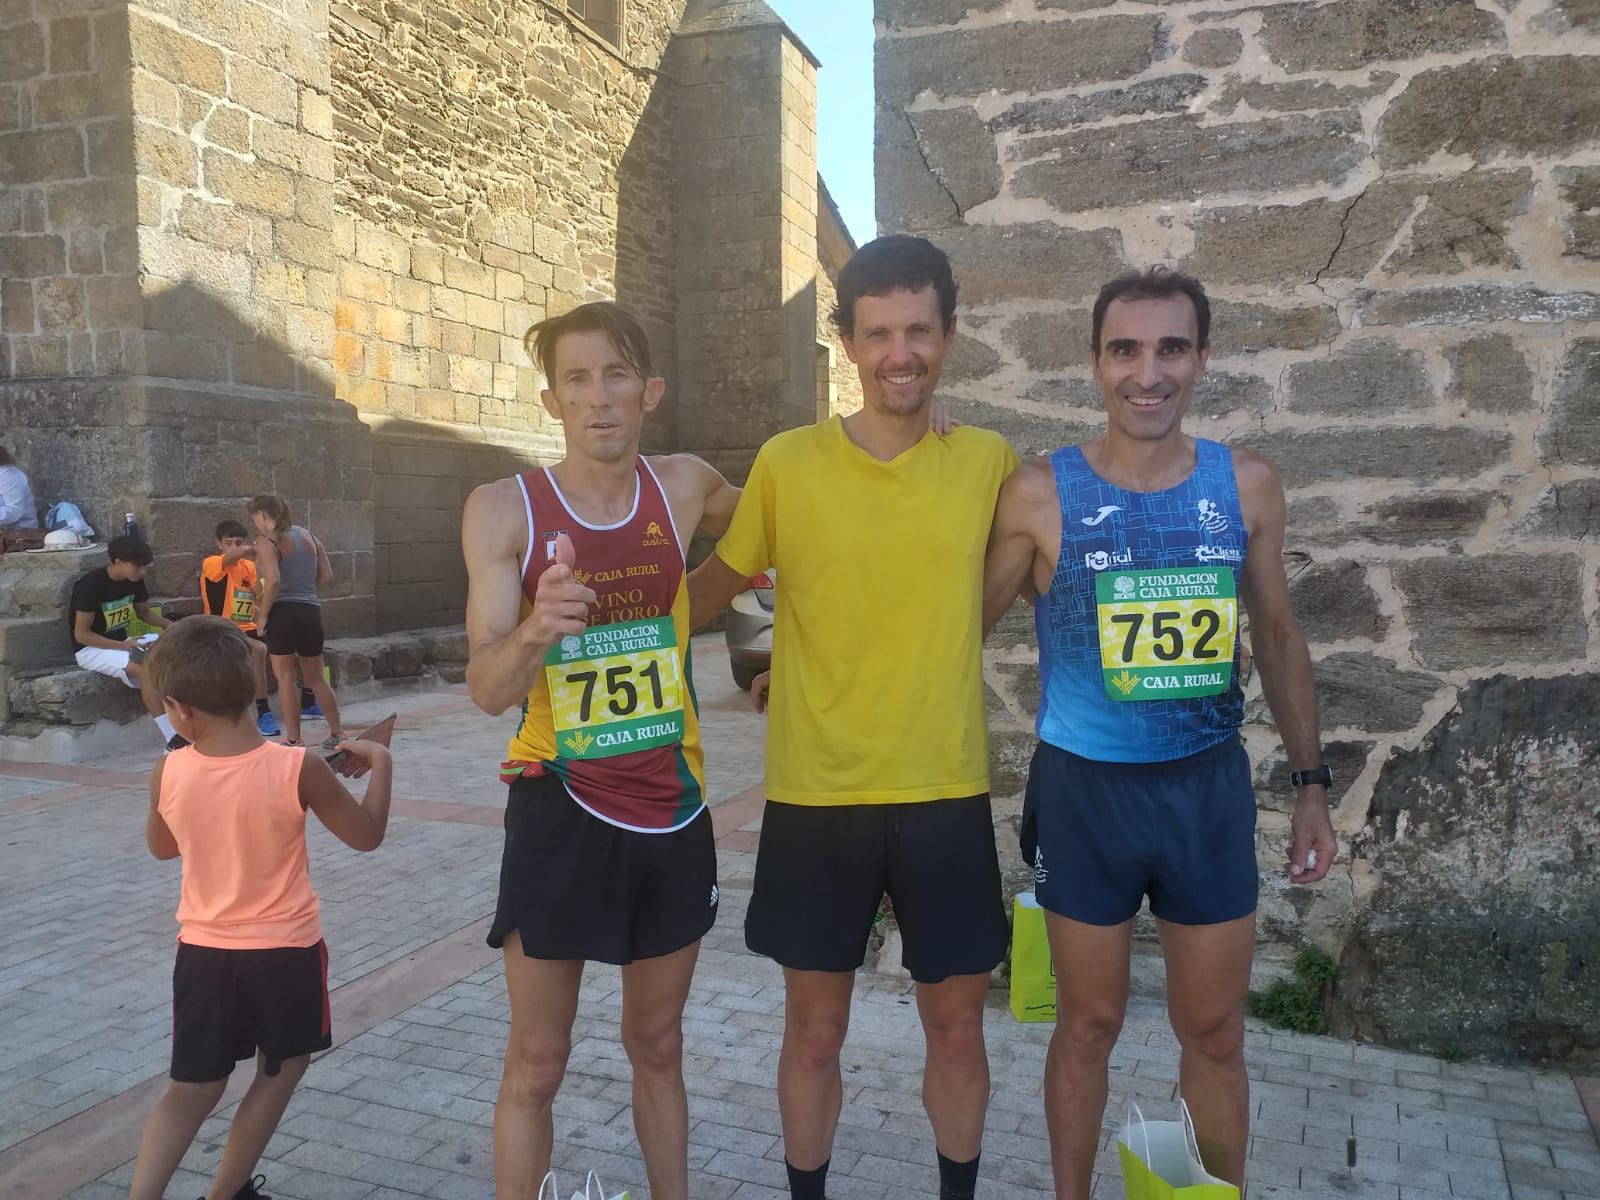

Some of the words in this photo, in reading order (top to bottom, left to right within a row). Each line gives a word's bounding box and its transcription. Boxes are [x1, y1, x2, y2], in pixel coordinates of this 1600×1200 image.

[594, 569, 623, 582] CAJA
[626, 564, 661, 577] RURAL
[1139, 573, 1218, 587] FUNDACION
[594, 588, 643, 610] VINO
[1139, 587, 1172, 599] CAJA
[1176, 584, 1219, 597] RURAL
[108, 607, 130, 626] 773
[607, 604, 660, 624] TORO
[584, 624, 660, 645] FUNDACION
[1110, 609, 1220, 663] 752
[586, 642, 618, 656] CAJA
[621, 636, 661, 650] RURAL
[565, 660, 664, 722] 751
[1142, 676, 1181, 689] CAJA
[1183, 673, 1224, 688] RURAL
[596, 731, 634, 747] CAJA
[635, 721, 679, 741] RURAL
